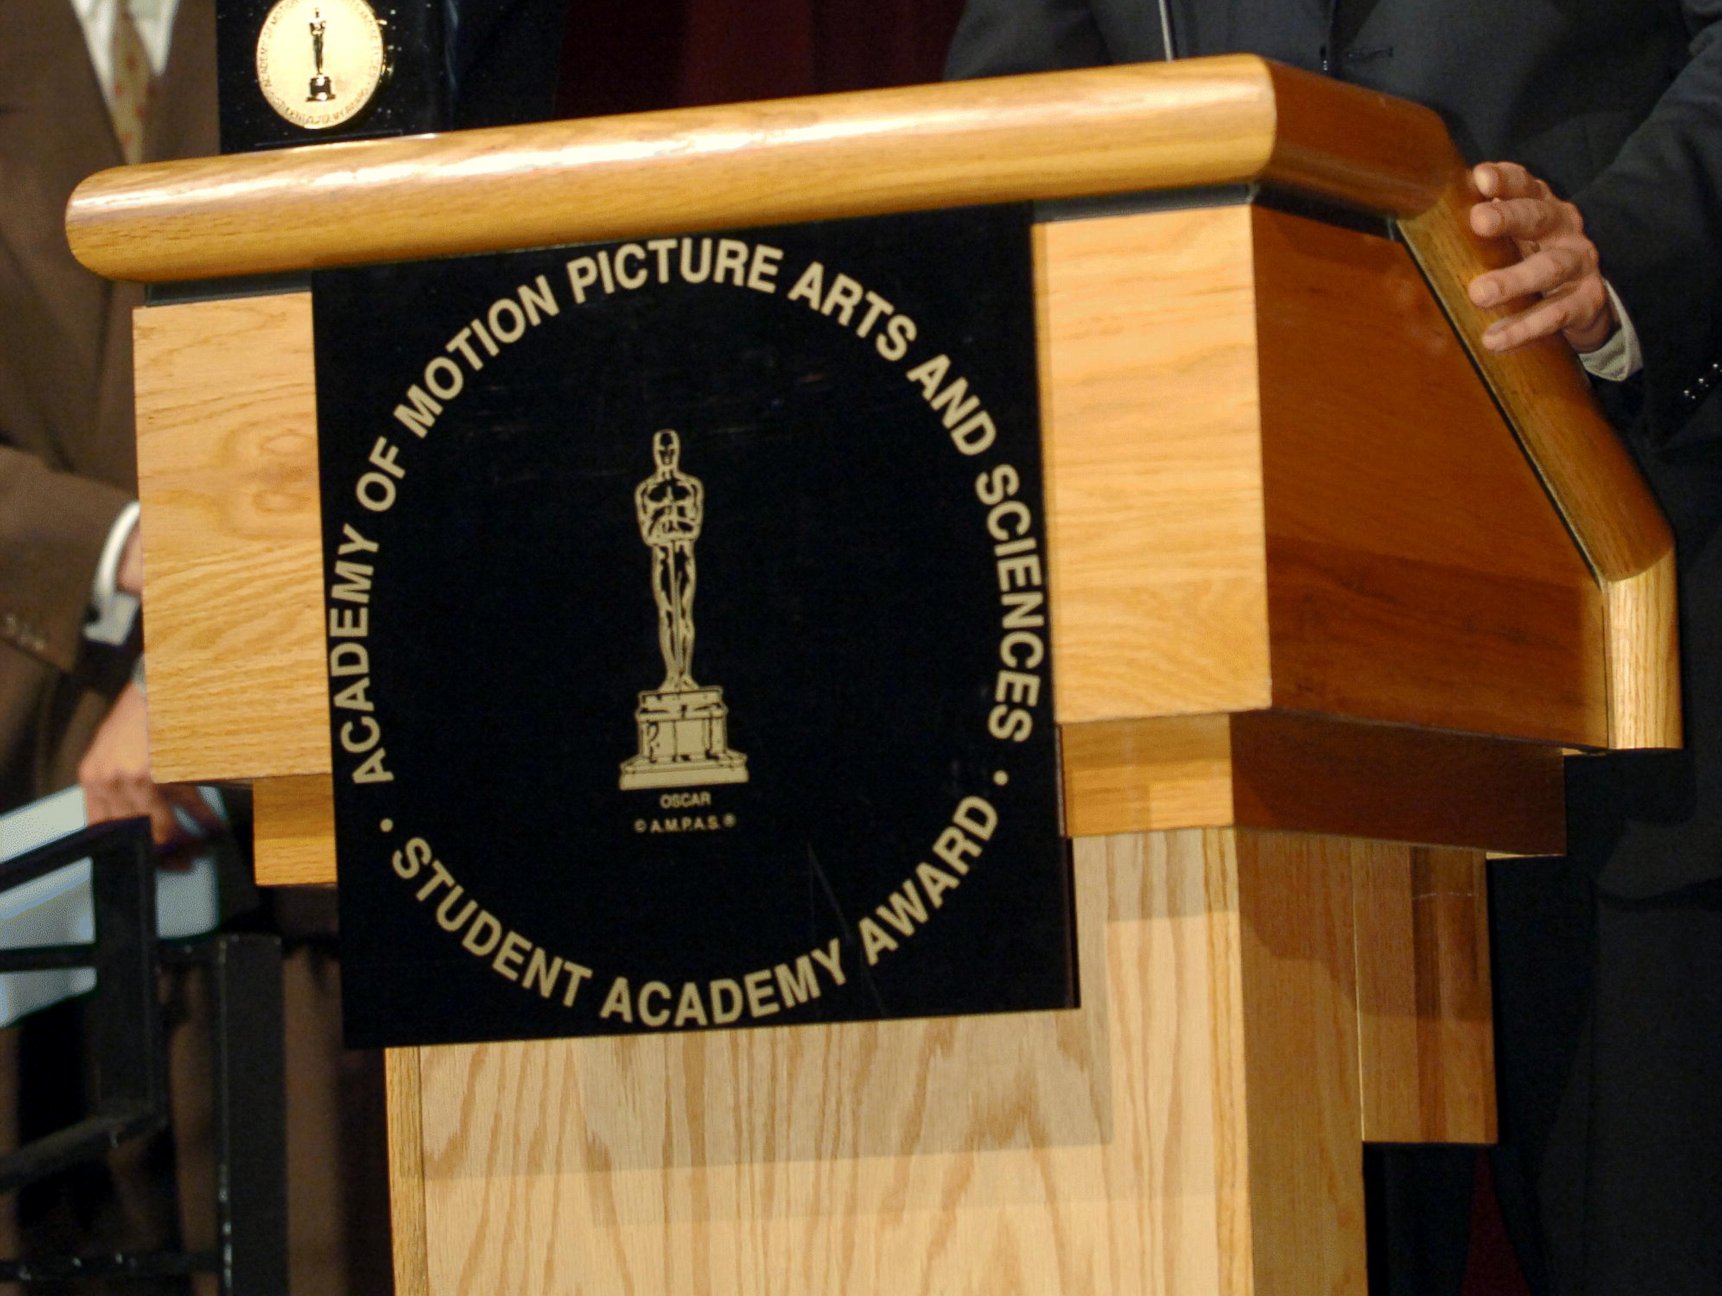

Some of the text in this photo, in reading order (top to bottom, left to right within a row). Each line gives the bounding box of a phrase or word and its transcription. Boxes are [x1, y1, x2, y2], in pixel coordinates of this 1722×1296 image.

[331, 239, 1045, 784] ACADEMY OF MOTION PICTURE ARTS AND SCIENCES
[392, 797, 998, 1025] STUDENT ACADEMY AWARD
[660, 792, 711, 808] OSCAR
